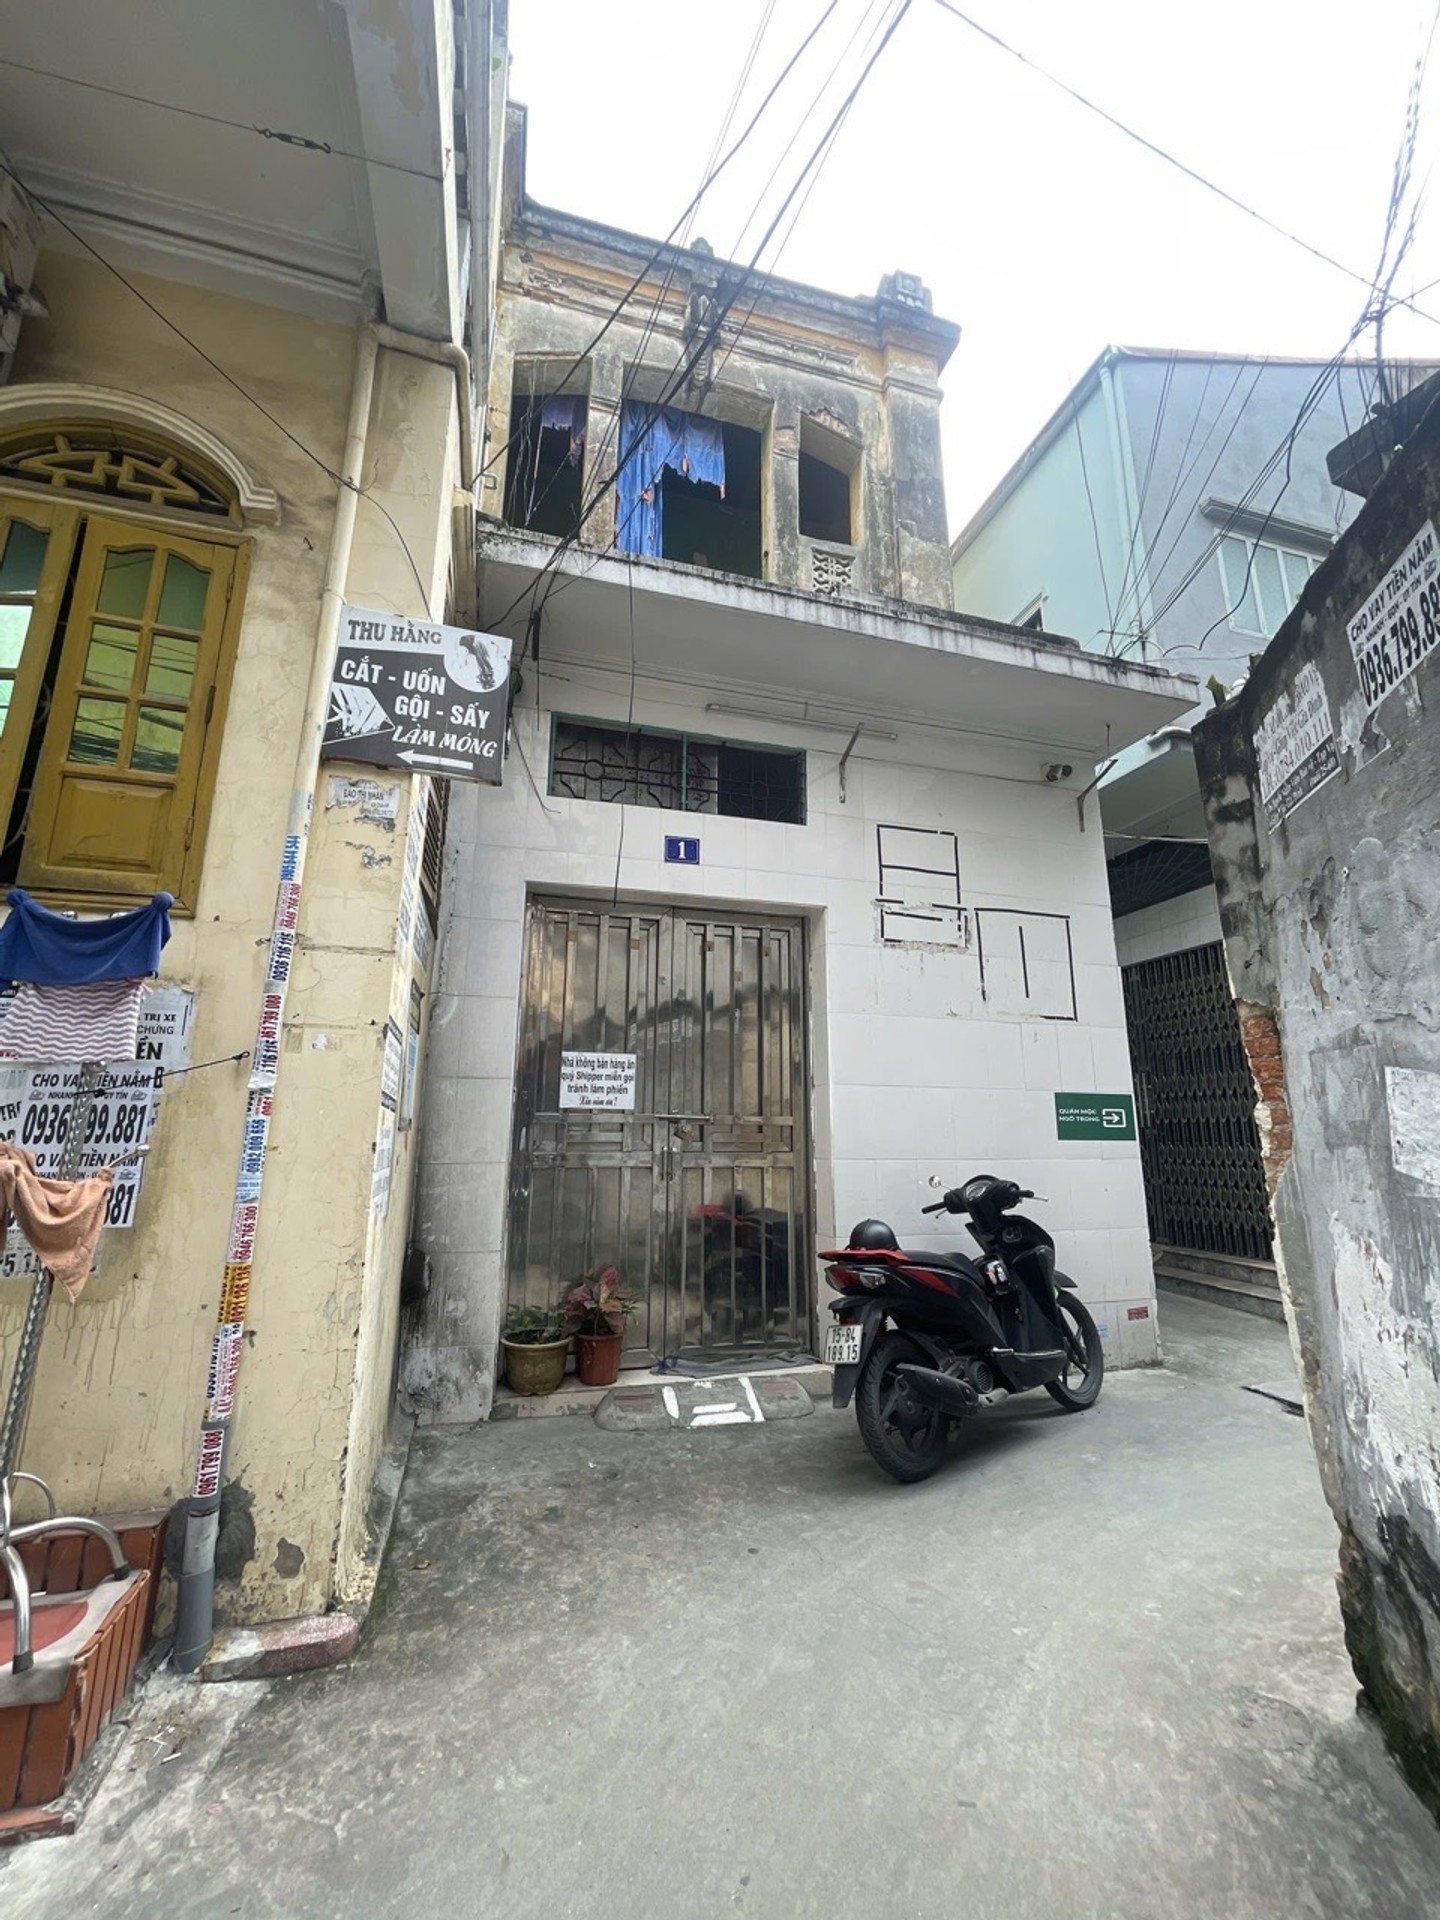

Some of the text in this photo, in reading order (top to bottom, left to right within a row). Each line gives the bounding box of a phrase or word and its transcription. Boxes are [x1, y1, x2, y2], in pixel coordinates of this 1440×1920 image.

[1351, 613, 1368, 641] CHO
[1368, 590, 1386, 621] VAY
[1386, 564, 1408, 600] TIỀN
[348, 619, 387, 641] THU
[1360, 572, 1440, 706] 0936.799.88
[340, 655, 383, 684] CẮT
[402, 667, 446, 696] UỐN
[394, 694, 430, 721] GỘI
[450, 702, 490, 729] SẤY
[392, 724, 498, 758] LÀM MÓNG
[677, 841, 687, 859] 1
[163, 1013, 176, 1022] XE
[136, 1035, 163, 1060] ỀN
[575, 1056, 595, 1071] không
[32, 1073, 59, 1087] CHO
[63, 1073, 80, 1087] VA
[96, 1068, 119, 1088] IỀN
[576, 1071, 604, 1082] Shipper
[567, 1084, 589, 1093] tránh
[590, 1084, 604, 1093] làm
[1059, 1107, 1080, 1115] QUÁN
[22, 1103, 148, 1145] 093699.881
[79, 1148, 107, 1167] TIỀN
